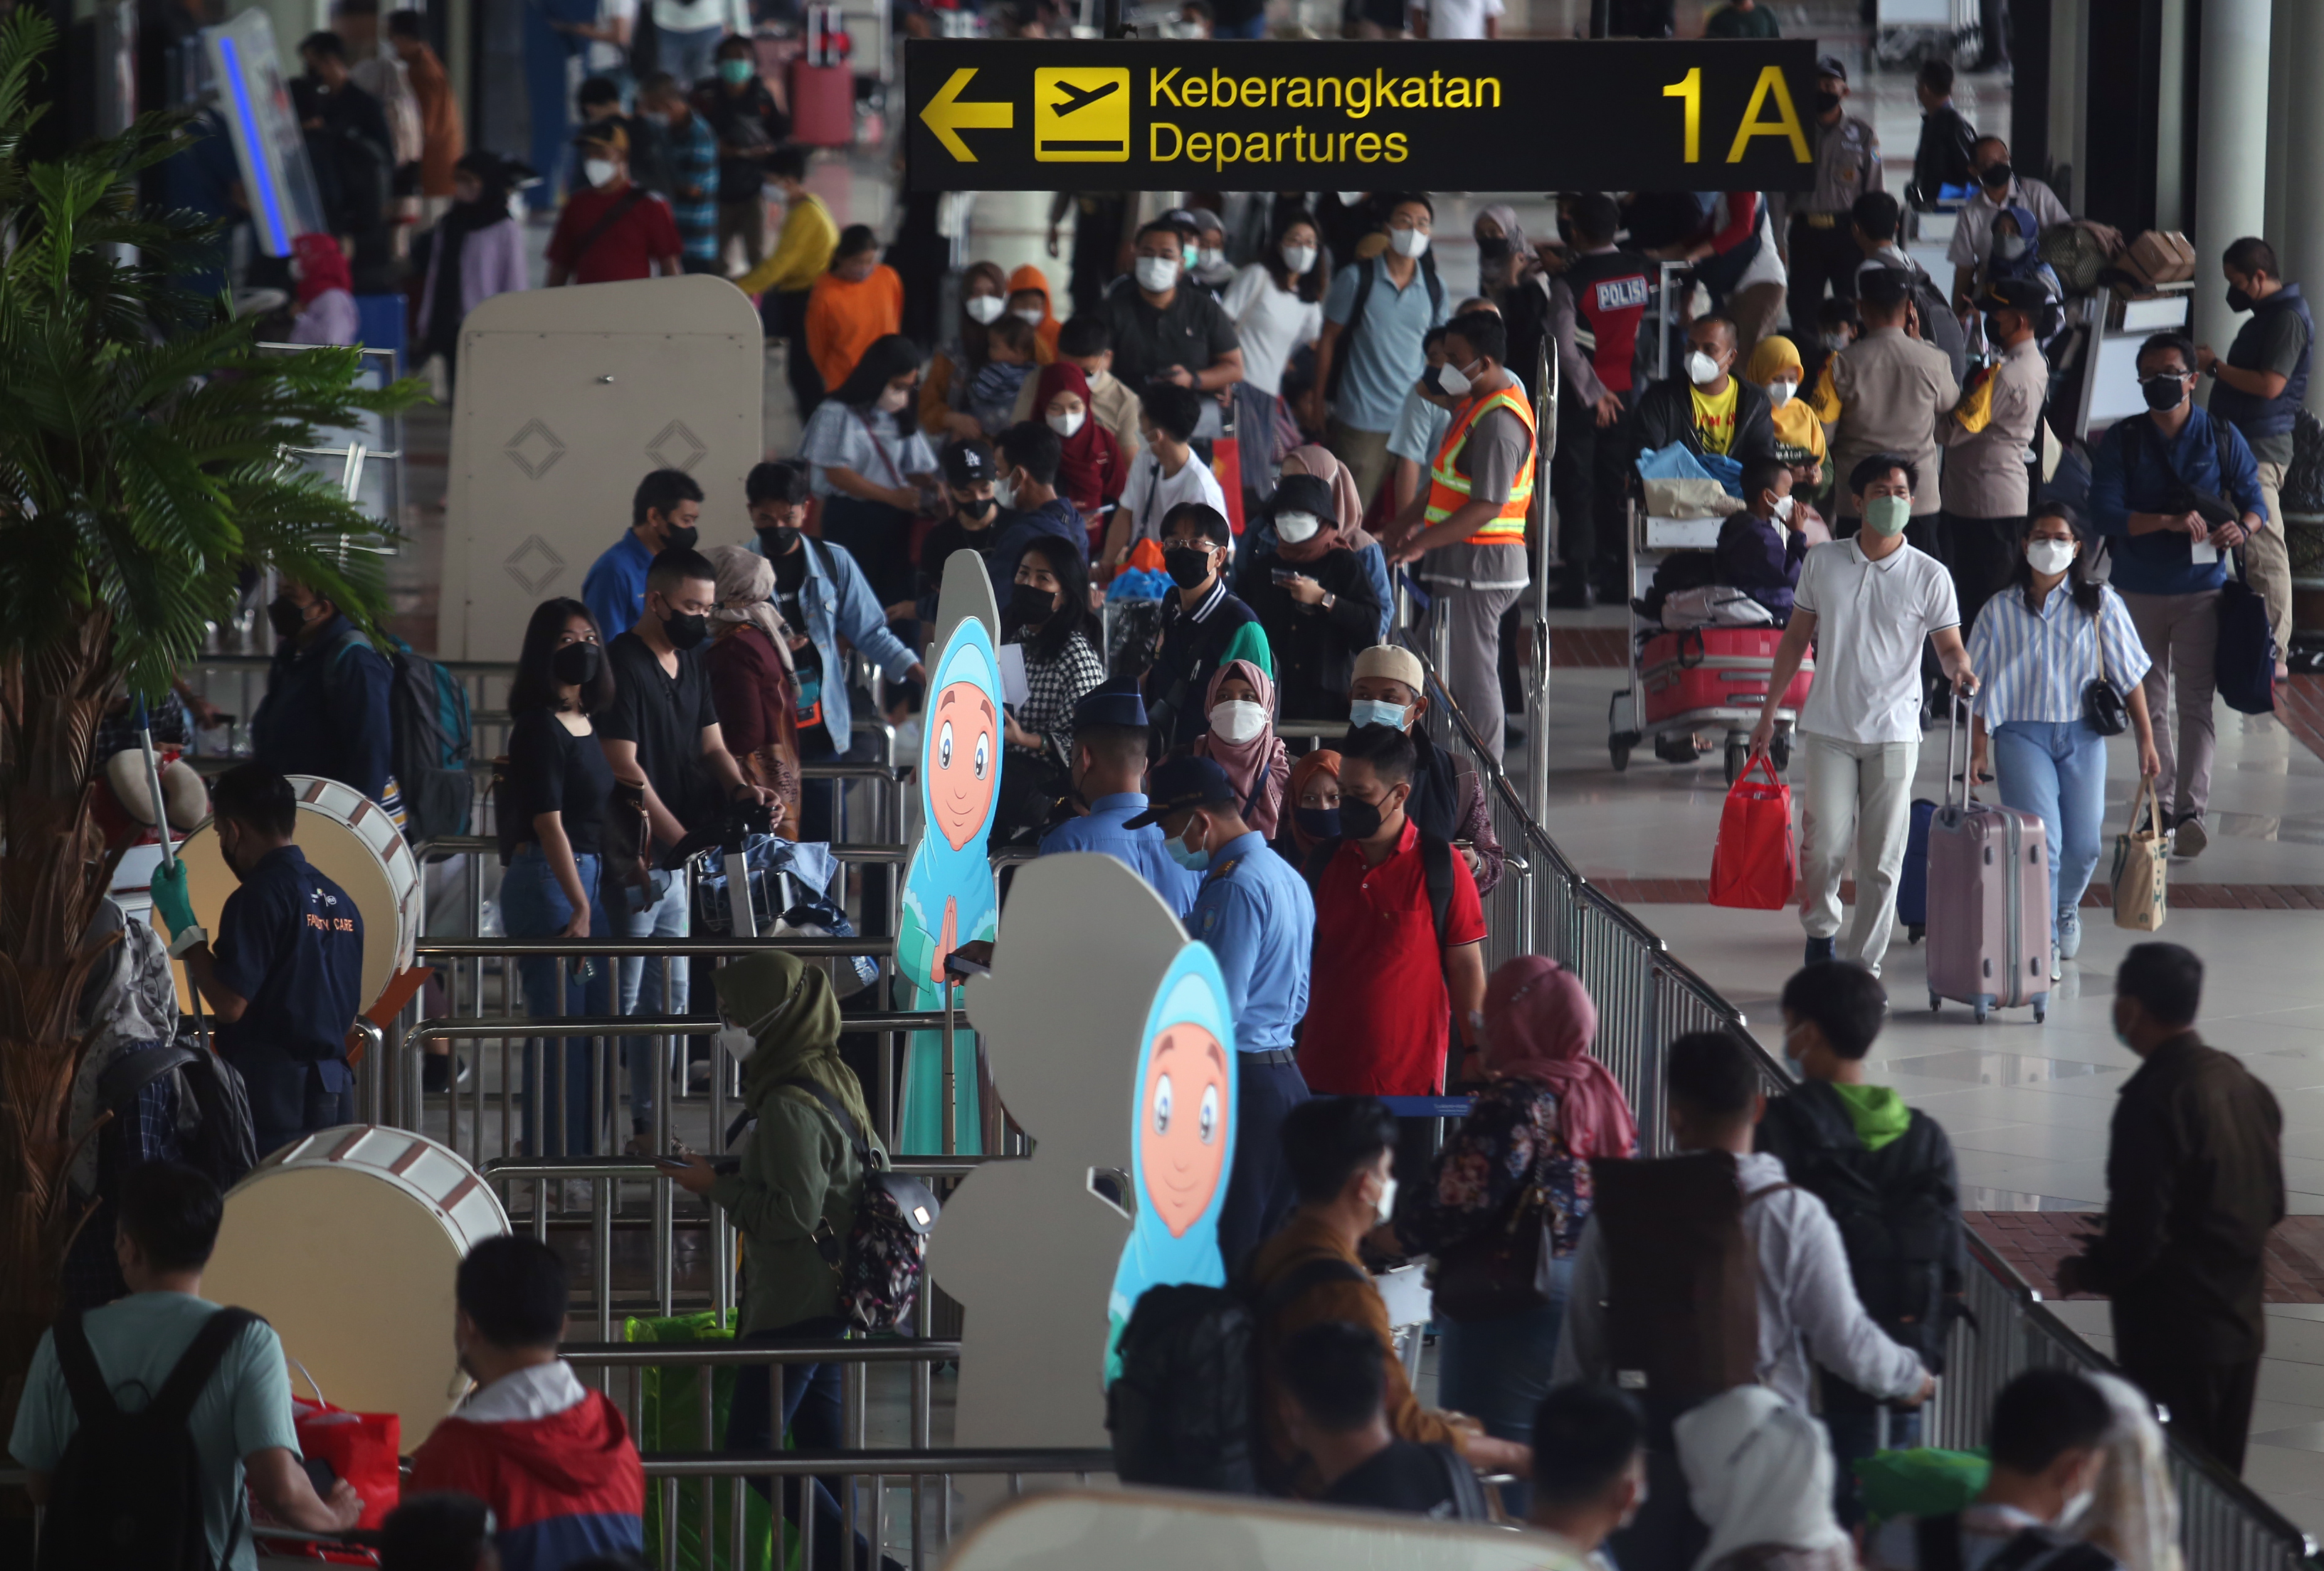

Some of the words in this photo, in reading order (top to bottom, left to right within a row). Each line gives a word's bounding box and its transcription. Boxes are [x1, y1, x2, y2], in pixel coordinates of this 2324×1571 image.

[1151, 68, 1501, 119] Keberangkatan
[1663, 68, 1701, 162] 1
[1726, 67, 1812, 163] A
[1151, 123, 1408, 171] Departures
[1599, 278, 1647, 307] POLISI
[963, 448, 981, 467] LA
[333, 919, 354, 931] CARE
